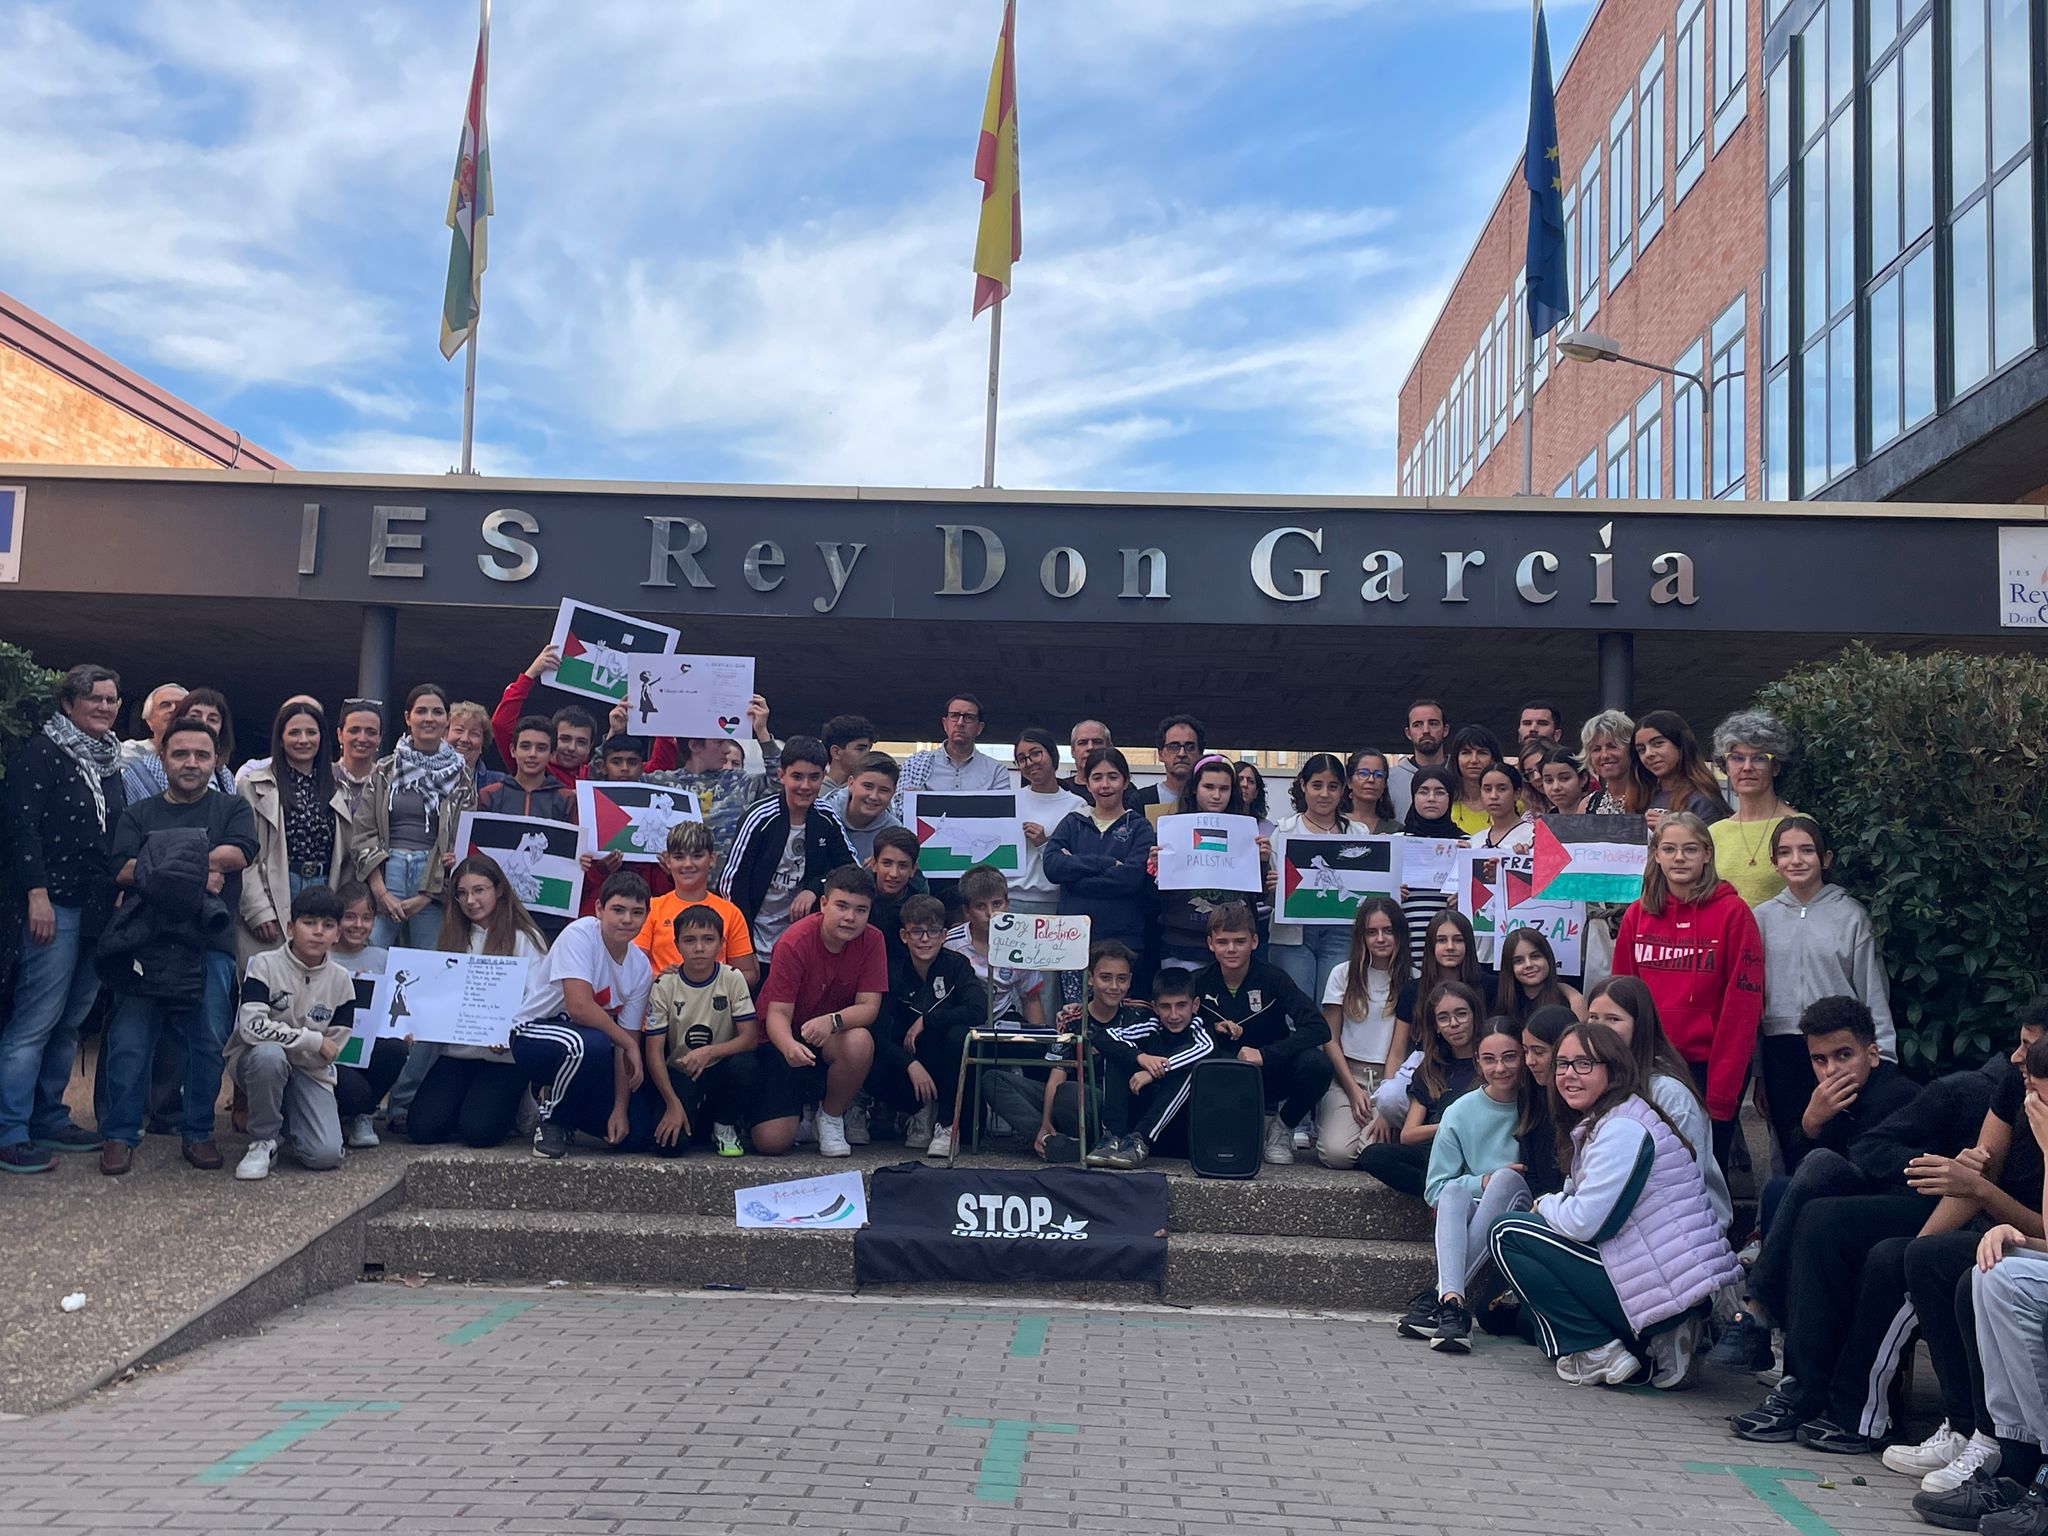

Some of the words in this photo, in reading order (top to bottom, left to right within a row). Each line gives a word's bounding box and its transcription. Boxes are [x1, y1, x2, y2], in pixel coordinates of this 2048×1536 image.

[297, 502, 540, 583] IES
[640, 515, 867, 613] Rey
[935, 523, 1171, 600] Don
[1250, 521, 1700, 606] García
[993, 914, 1029, 938] Soy
[992, 936, 1026, 960] quiero
[1008, 947, 1064, 966] Colegio
[956, 1192, 1053, 1232] STOP
